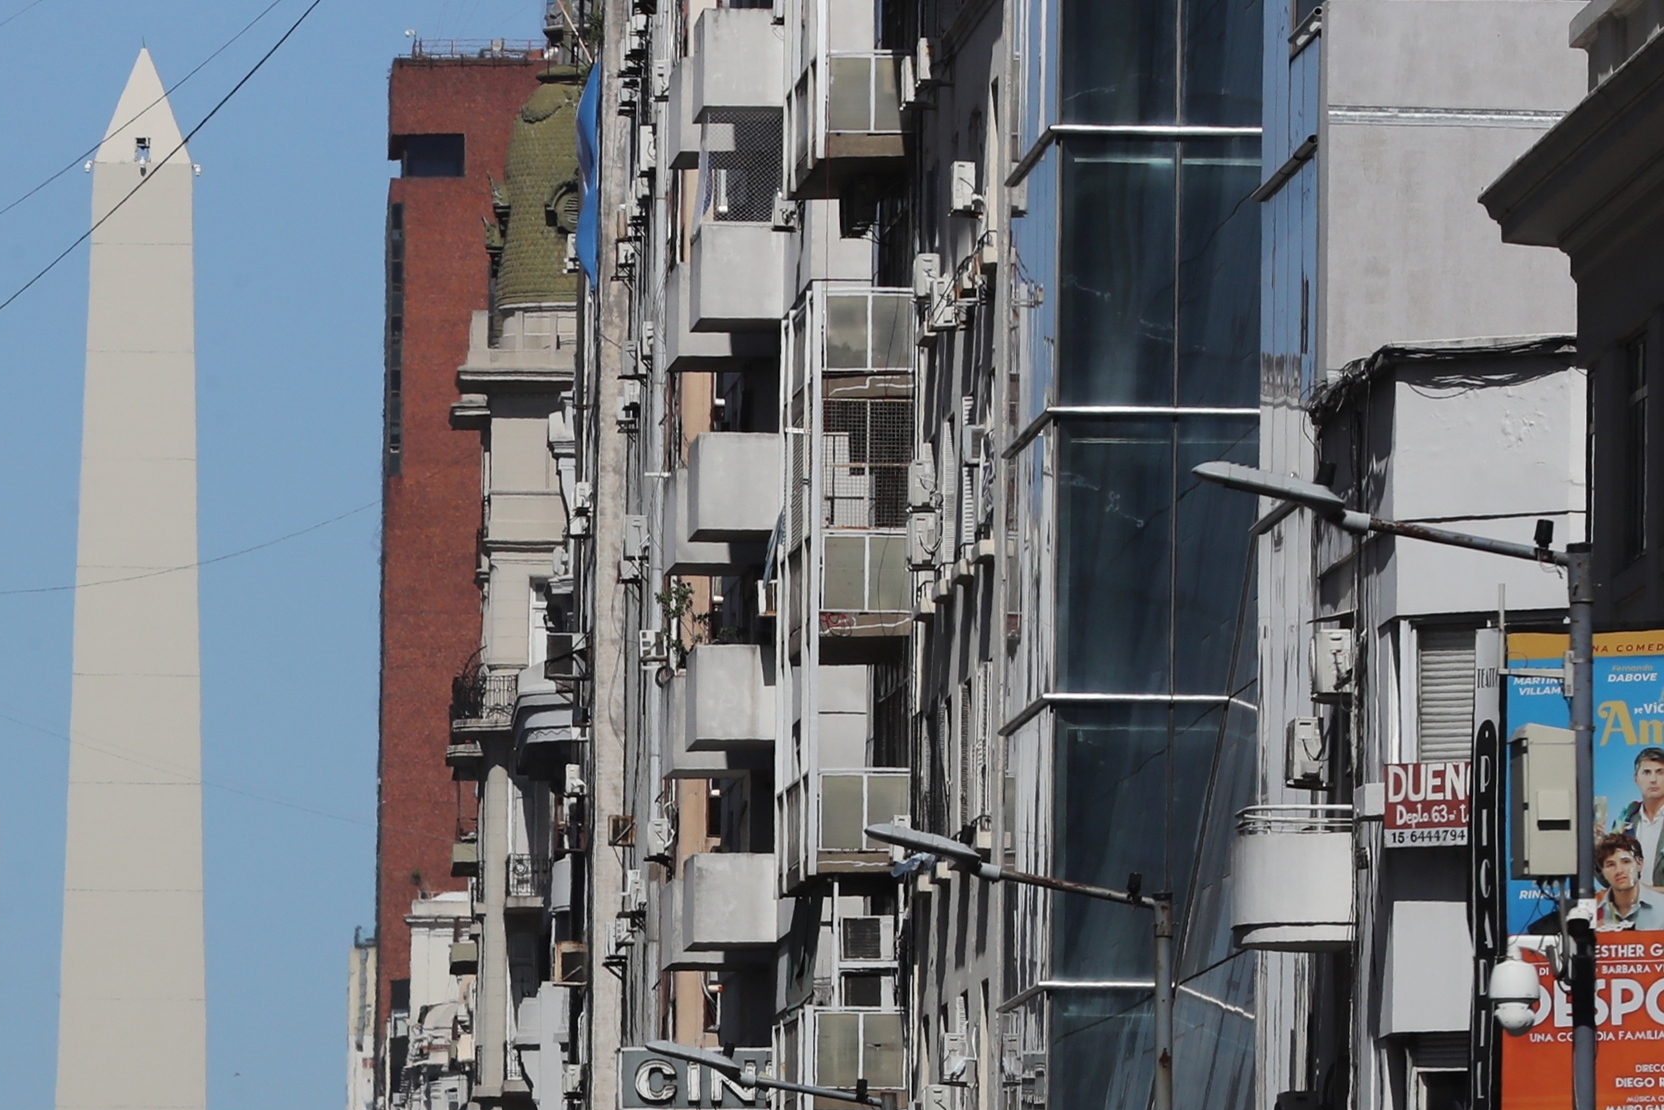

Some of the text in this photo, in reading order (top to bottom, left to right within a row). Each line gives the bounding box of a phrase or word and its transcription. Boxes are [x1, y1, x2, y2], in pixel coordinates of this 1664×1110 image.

[1607, 673, 1657, 682] DABOVE
[1518, 686, 1563, 696] VILLAM
[1557, 1031, 1615, 1042] CODIA
[1615, 1077, 1655, 1088] DIEGO
